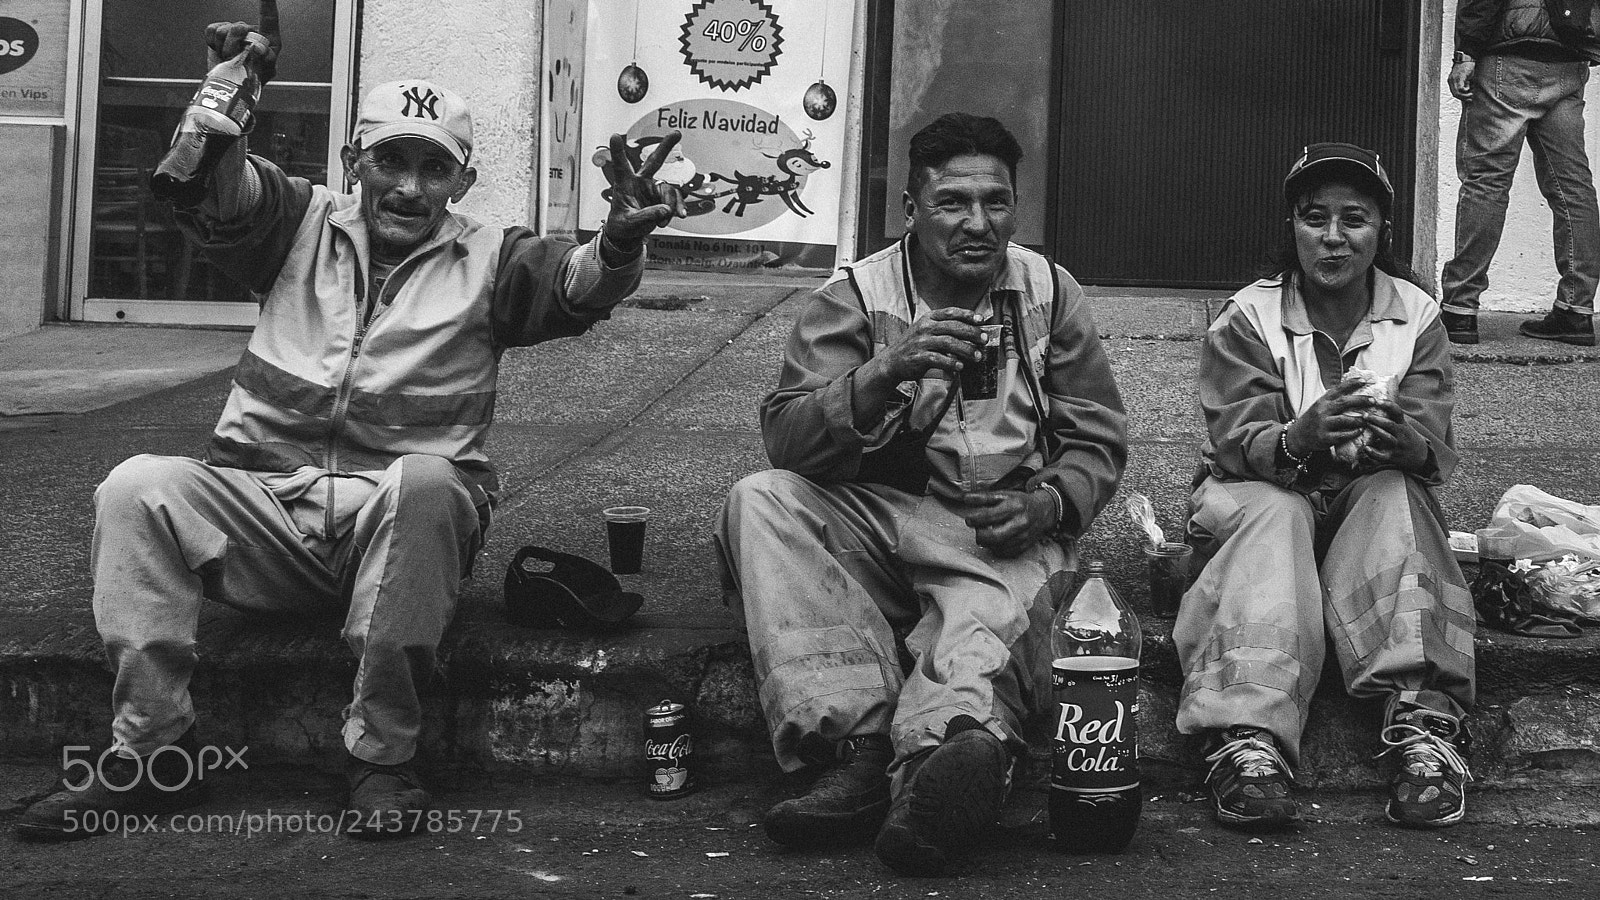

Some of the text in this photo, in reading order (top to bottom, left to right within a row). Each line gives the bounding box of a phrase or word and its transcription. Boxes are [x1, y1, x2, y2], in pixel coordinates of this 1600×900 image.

[703, 19, 767, 52] 40%
[21, 88, 48, 100] Vips
[401, 86, 440, 120] NY
[657, 107, 780, 134] Feliz Navidad
[1054, 701, 1126, 744] Red
[1067, 746, 1119, 772] Cola
